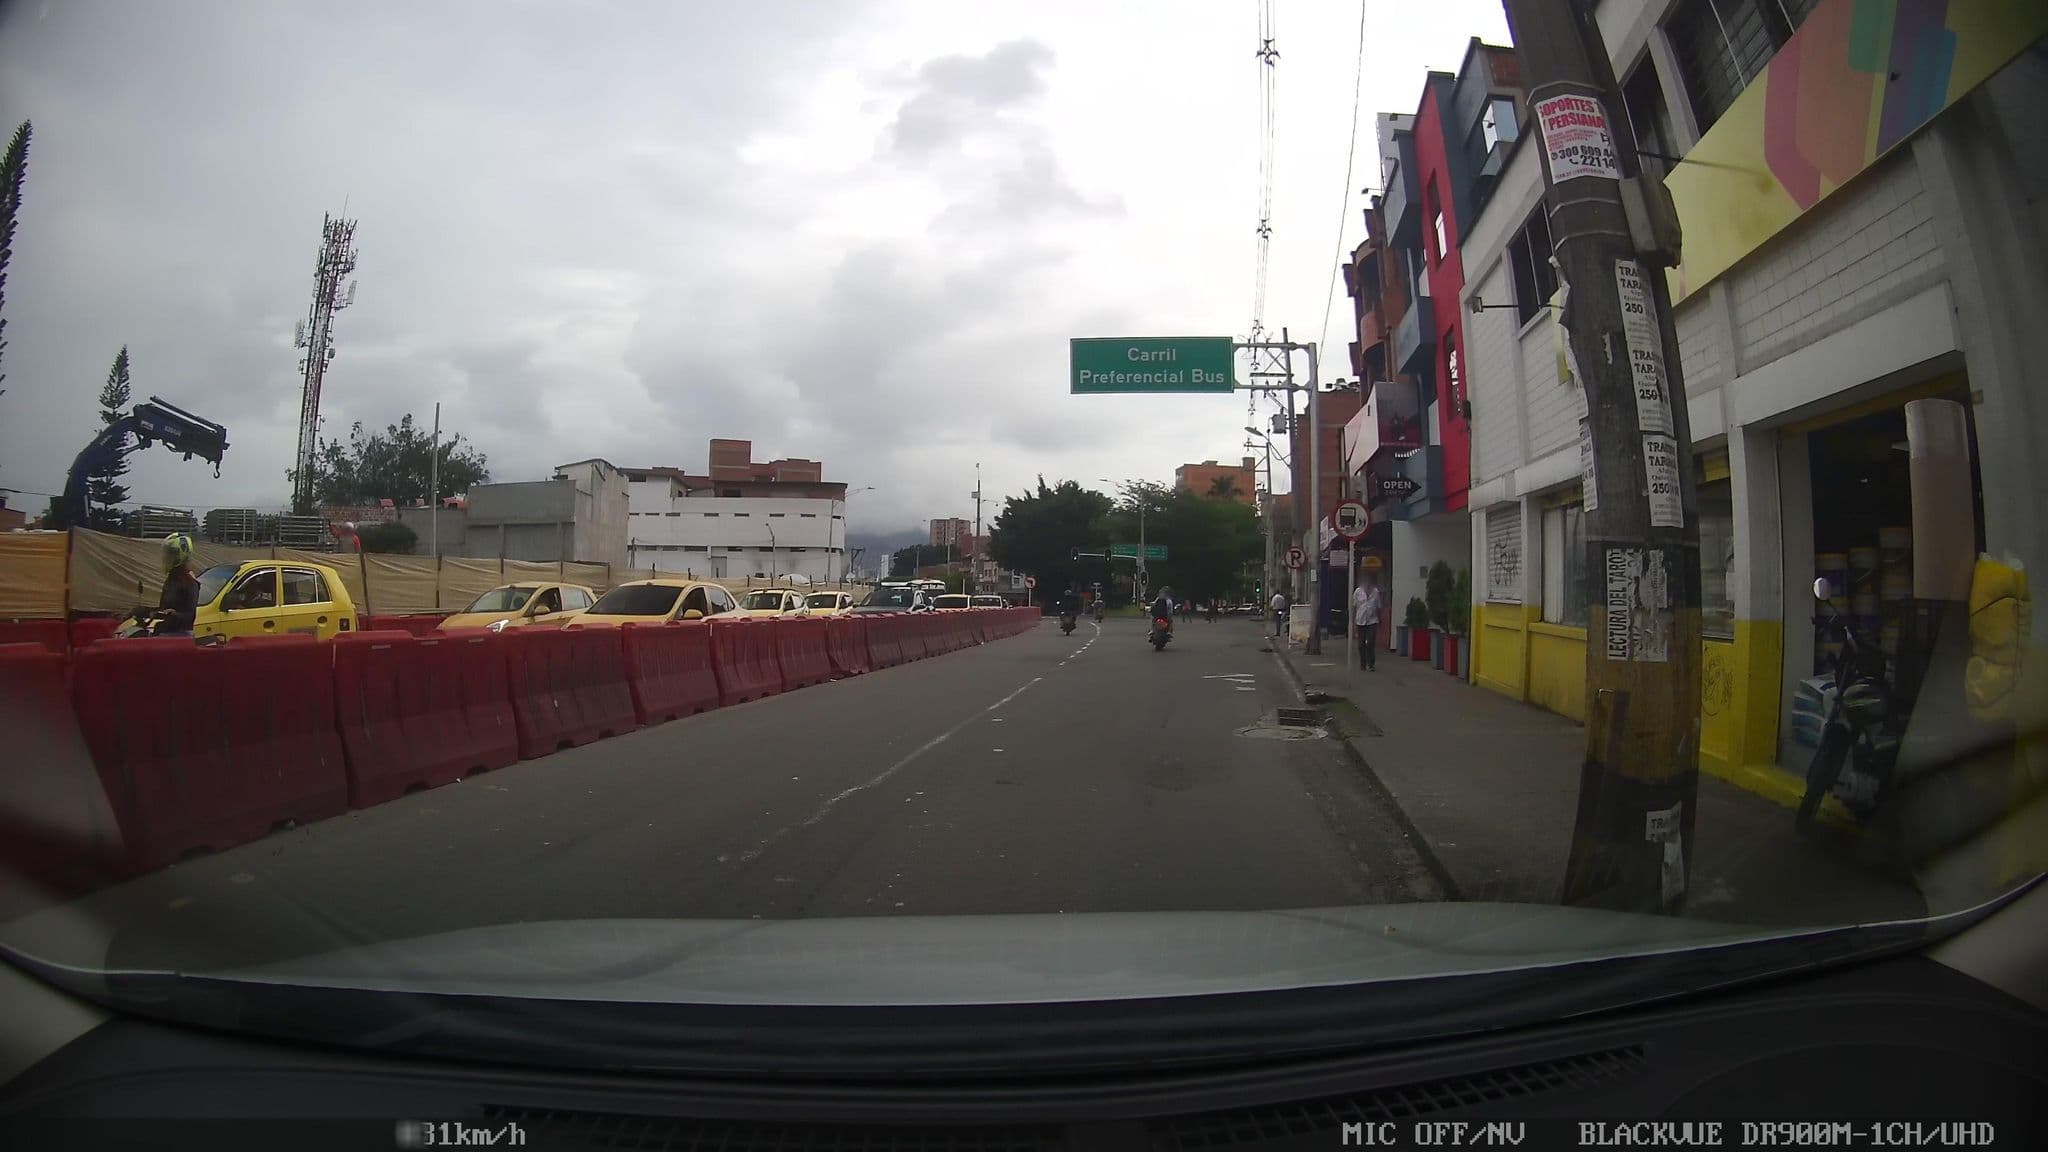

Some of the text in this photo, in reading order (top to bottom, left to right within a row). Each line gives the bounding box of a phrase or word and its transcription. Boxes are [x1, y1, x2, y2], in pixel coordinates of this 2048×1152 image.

[1559, 146, 1579, 159] 300
[1625, 302, 1643, 314] 250
[1127, 347, 1176, 361] Carril
[1079, 368, 1225, 384] Preferencial Bus
[1639, 389, 1657, 400] 250
[1383, 481, 1412, 489] OPEN
[1652, 483, 1669, 494] 250
[1608, 587, 1627, 607] DEL
[1608, 609, 1627, 658] LECTURA
